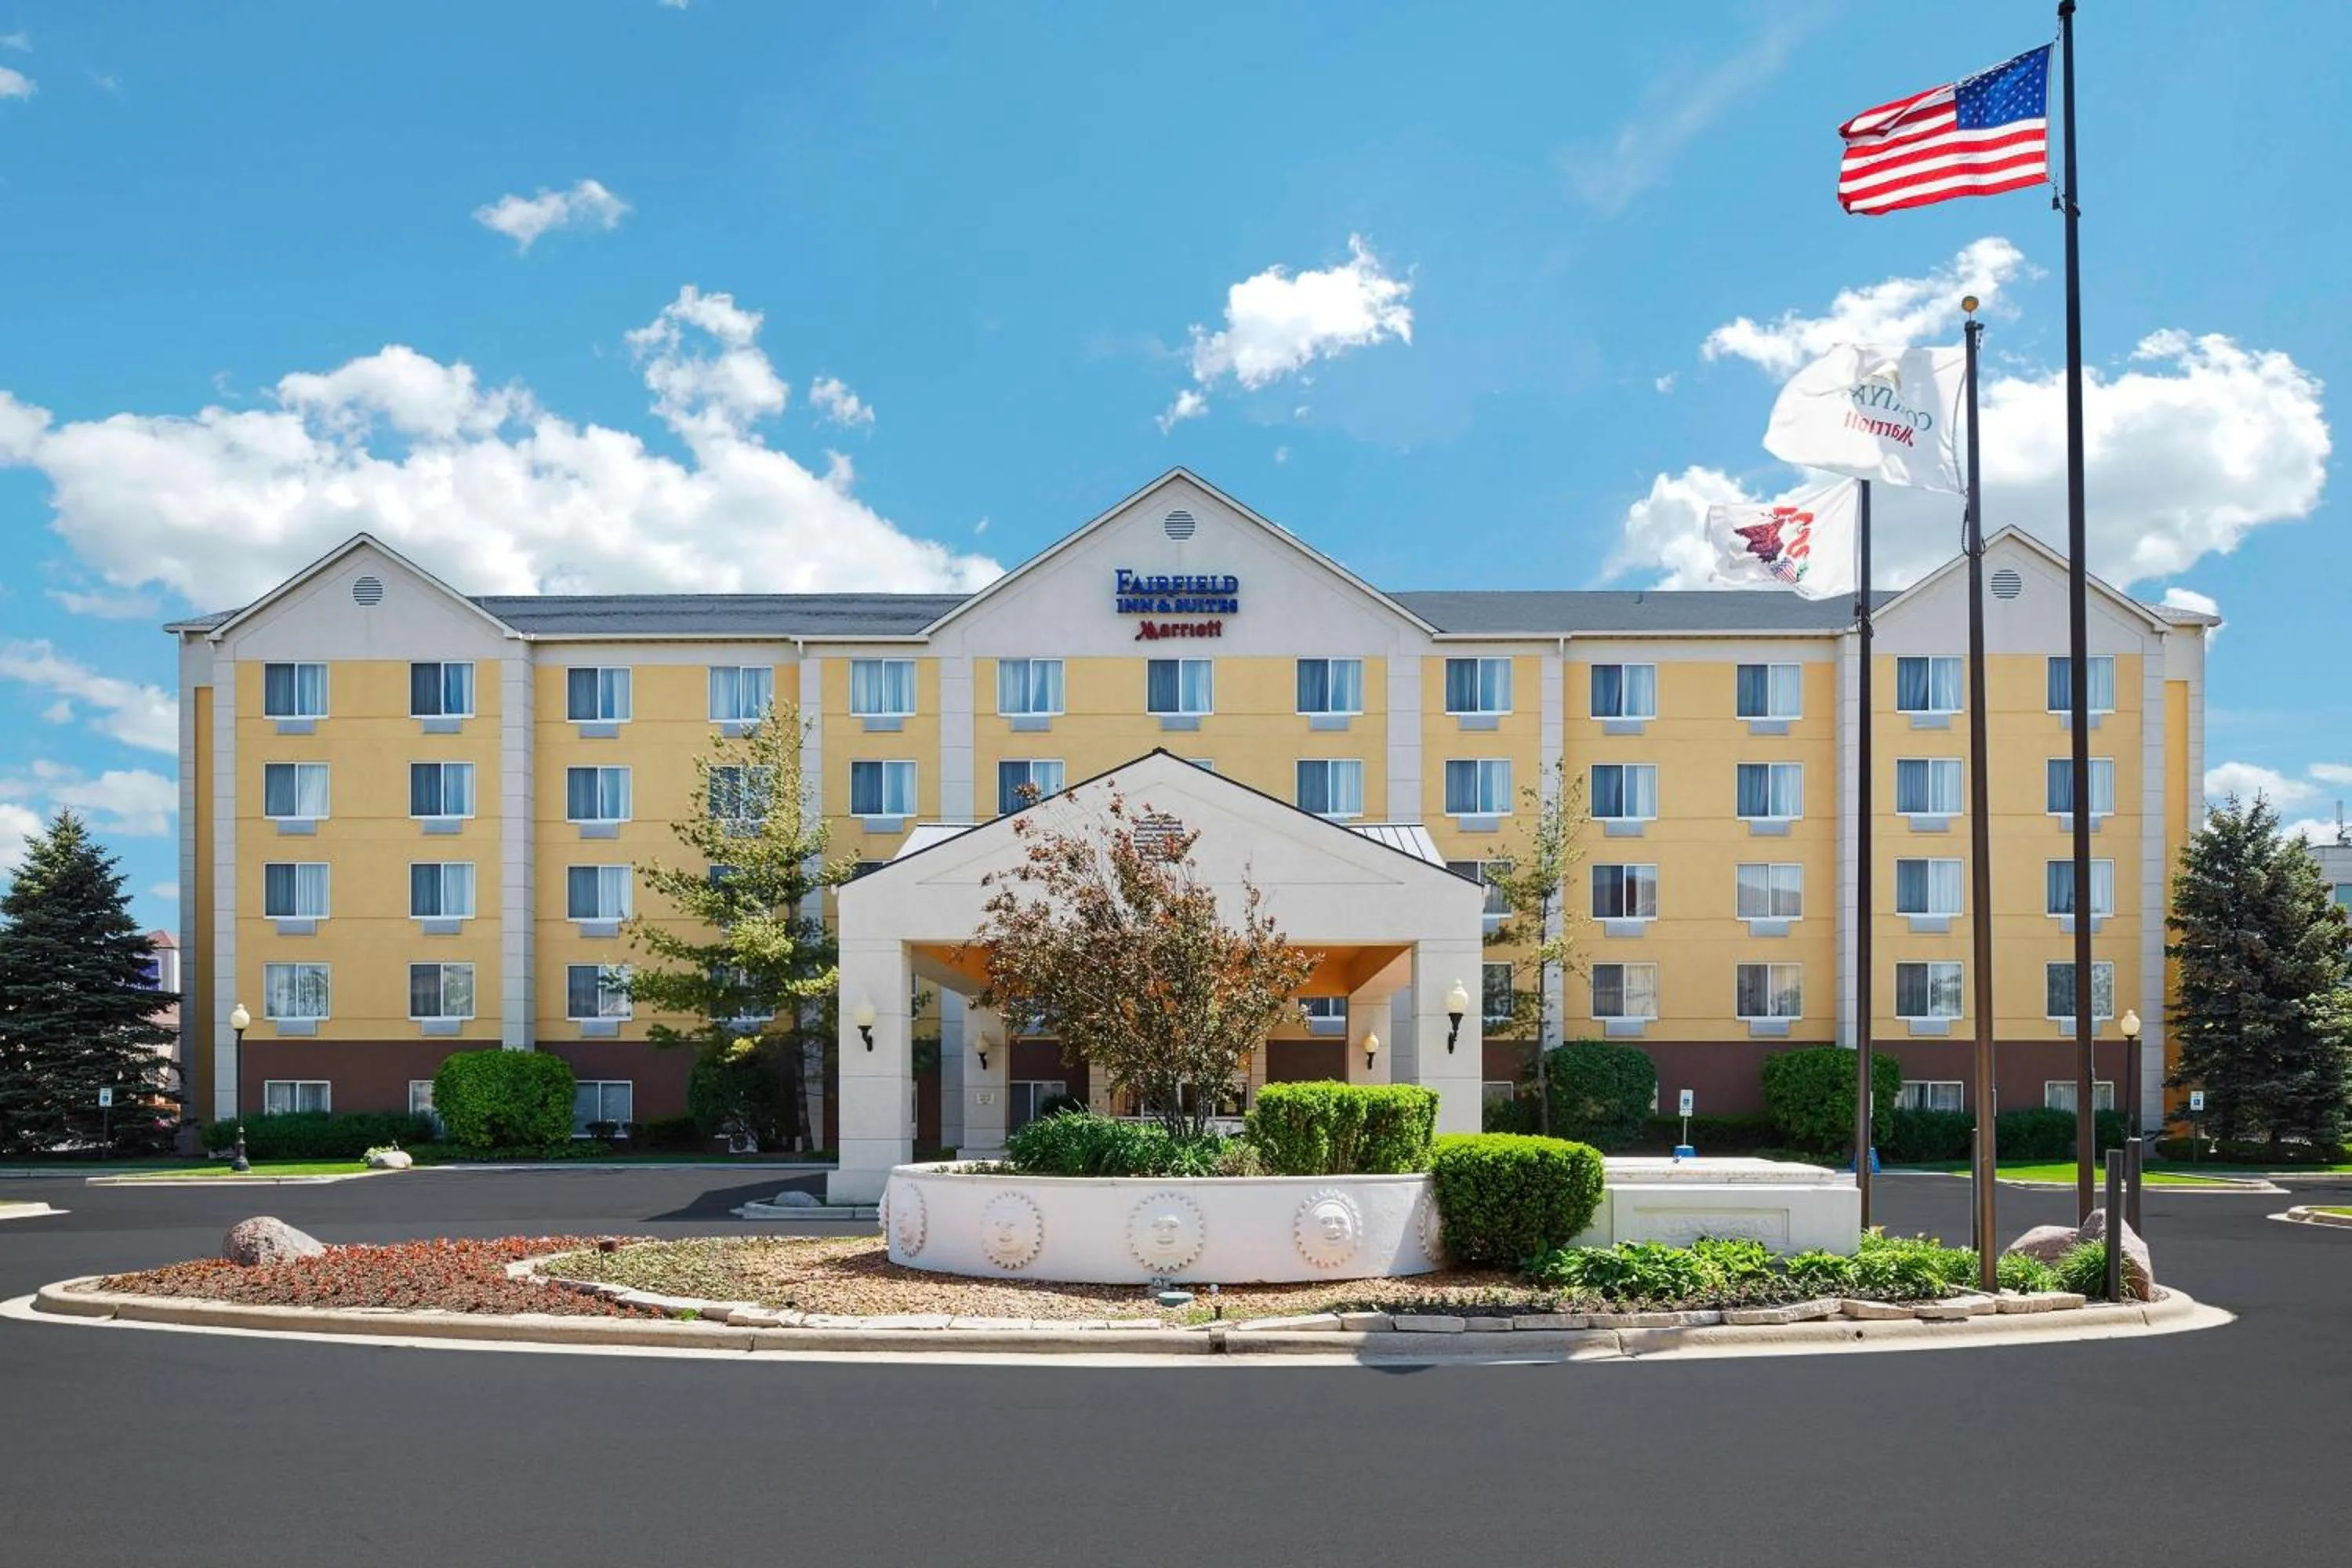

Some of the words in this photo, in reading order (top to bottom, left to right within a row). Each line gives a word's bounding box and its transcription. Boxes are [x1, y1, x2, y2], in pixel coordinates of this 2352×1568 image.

[1115, 568, 1239, 597] FAIRFIELD
[1116, 598, 1154, 613] INN
[1157, 598, 1171, 613] &
[1175, 598, 1238, 613] SUITES
[1134, 619, 1222, 641] Marriott
